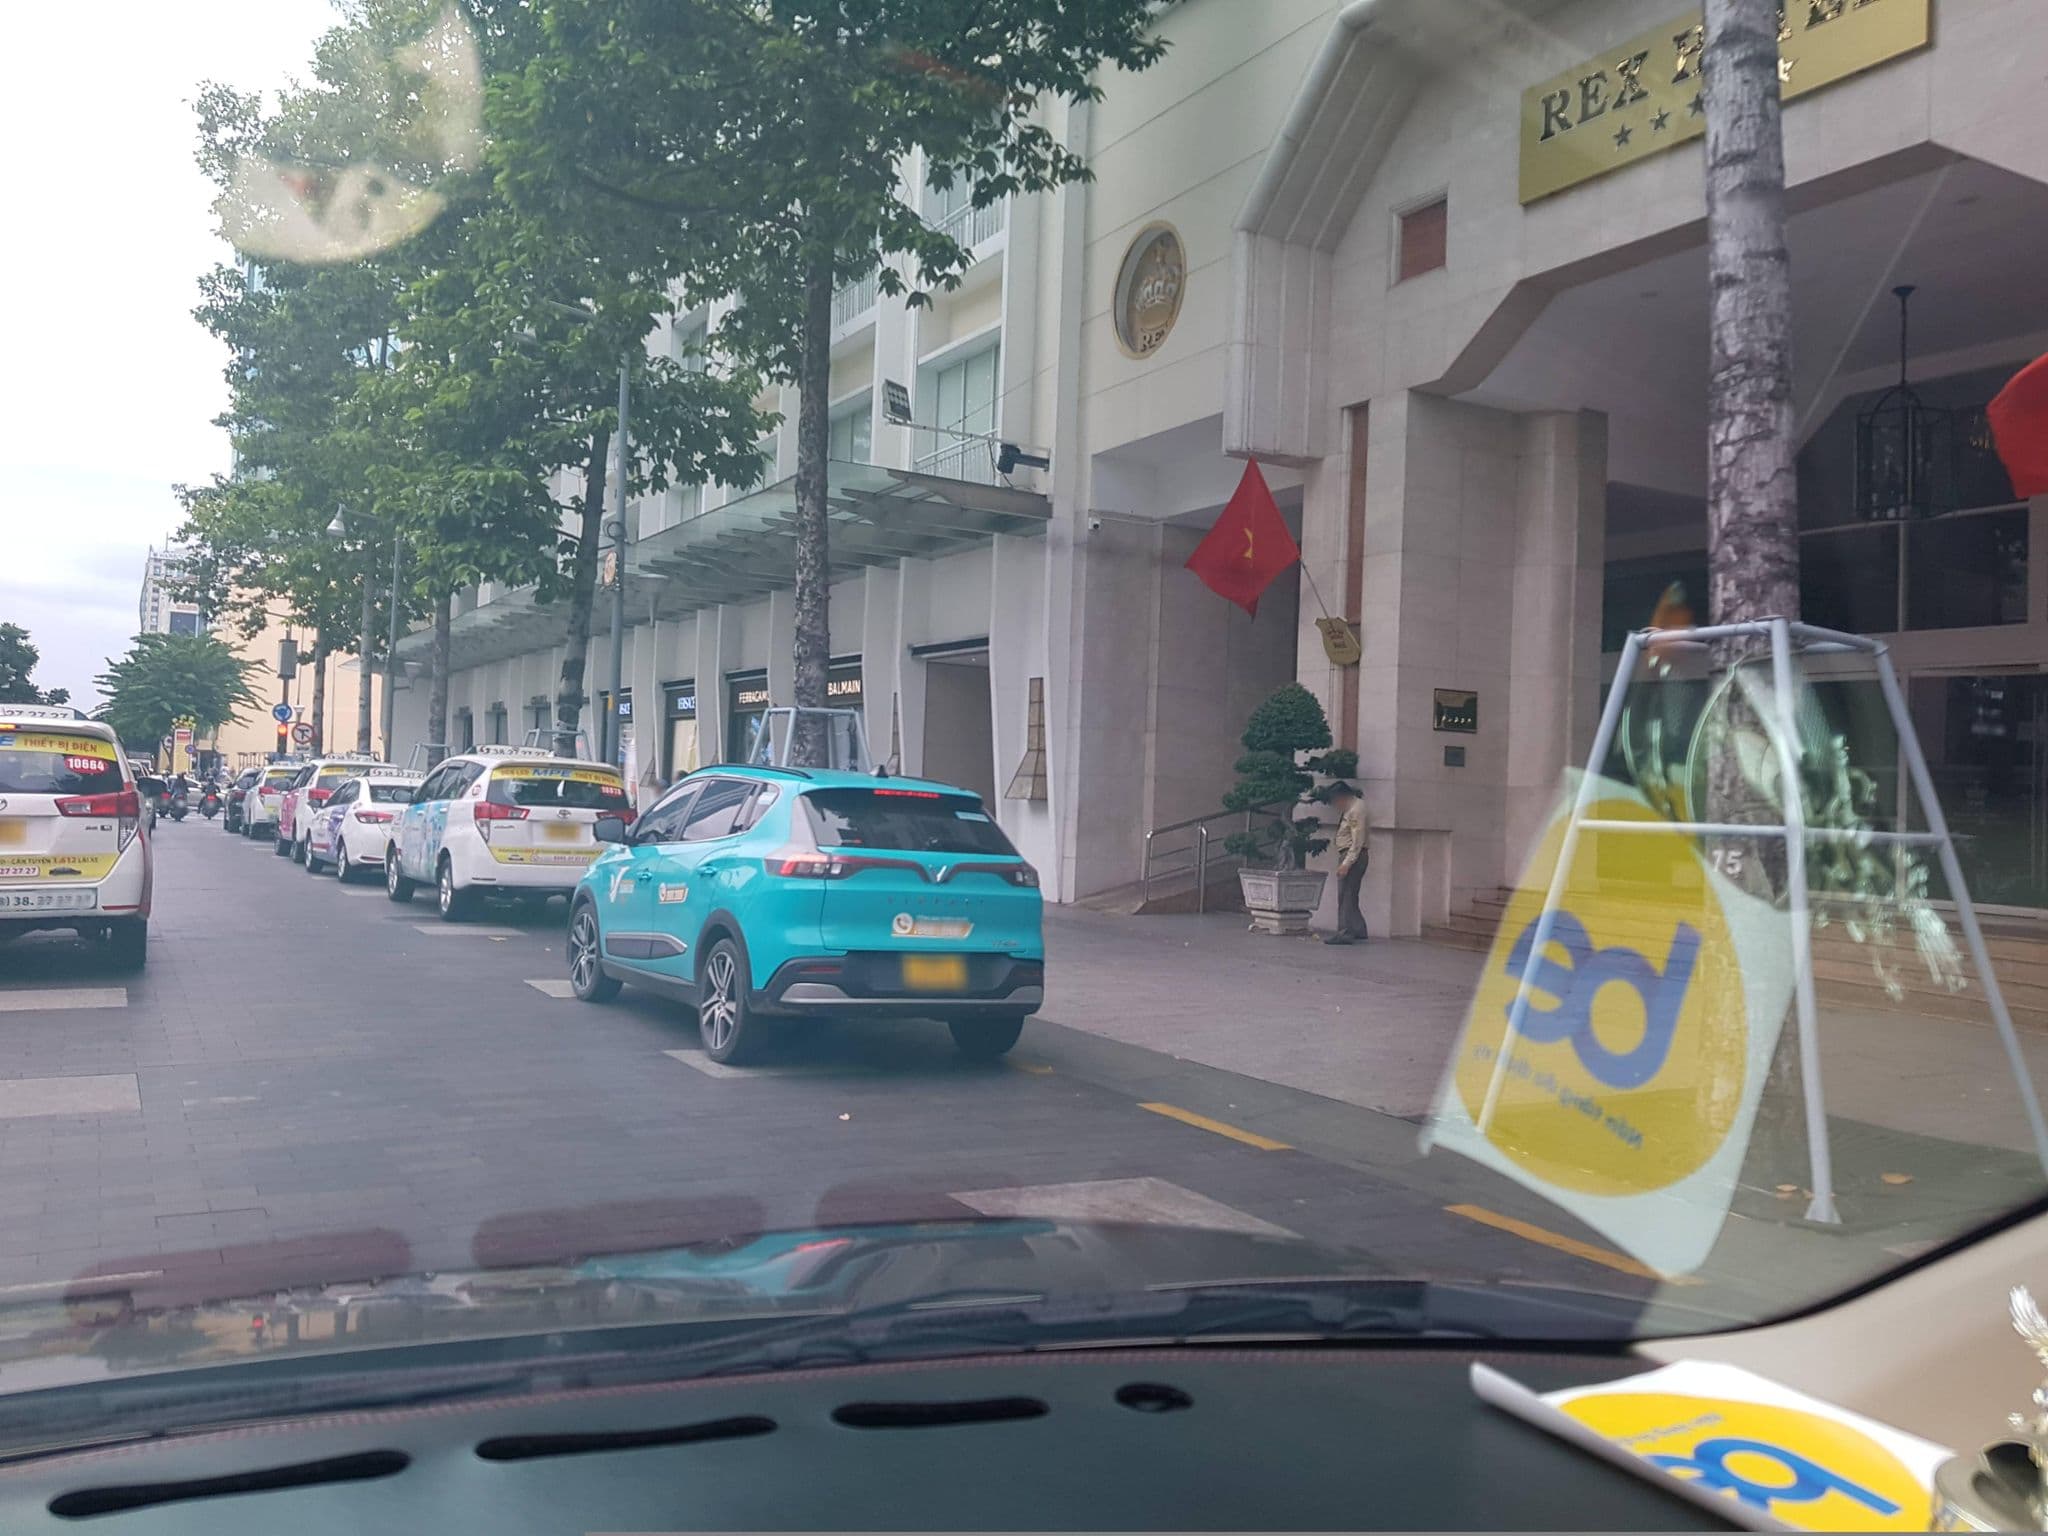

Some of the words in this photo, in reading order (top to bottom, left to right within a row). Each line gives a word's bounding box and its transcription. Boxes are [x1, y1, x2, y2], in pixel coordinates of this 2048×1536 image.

[1540, 50, 1649, 141] REX
[827, 680, 861, 696] BALMAIN
[532, 768, 571, 778] MPE
[1712, 849, 1743, 875] 75
